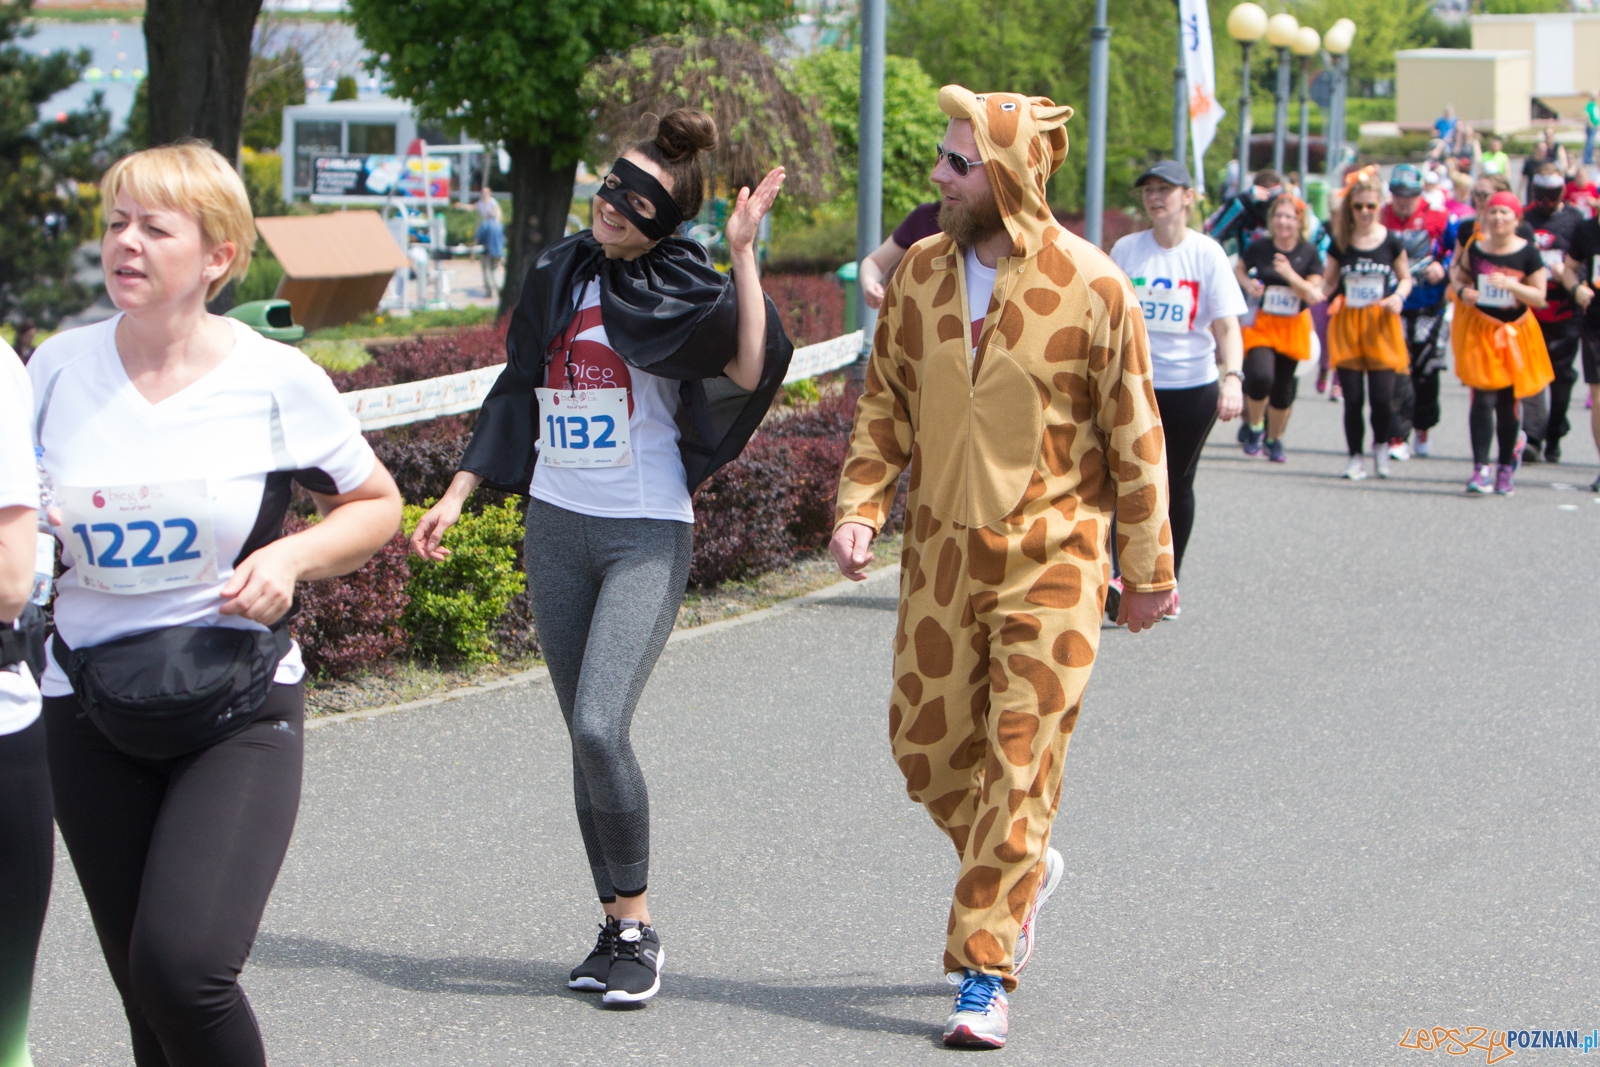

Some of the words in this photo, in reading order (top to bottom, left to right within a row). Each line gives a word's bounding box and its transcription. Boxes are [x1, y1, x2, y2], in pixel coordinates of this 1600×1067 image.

[564, 350, 617, 389] bieg
[546, 414, 617, 449] 1132
[72, 517, 202, 568] 1222
